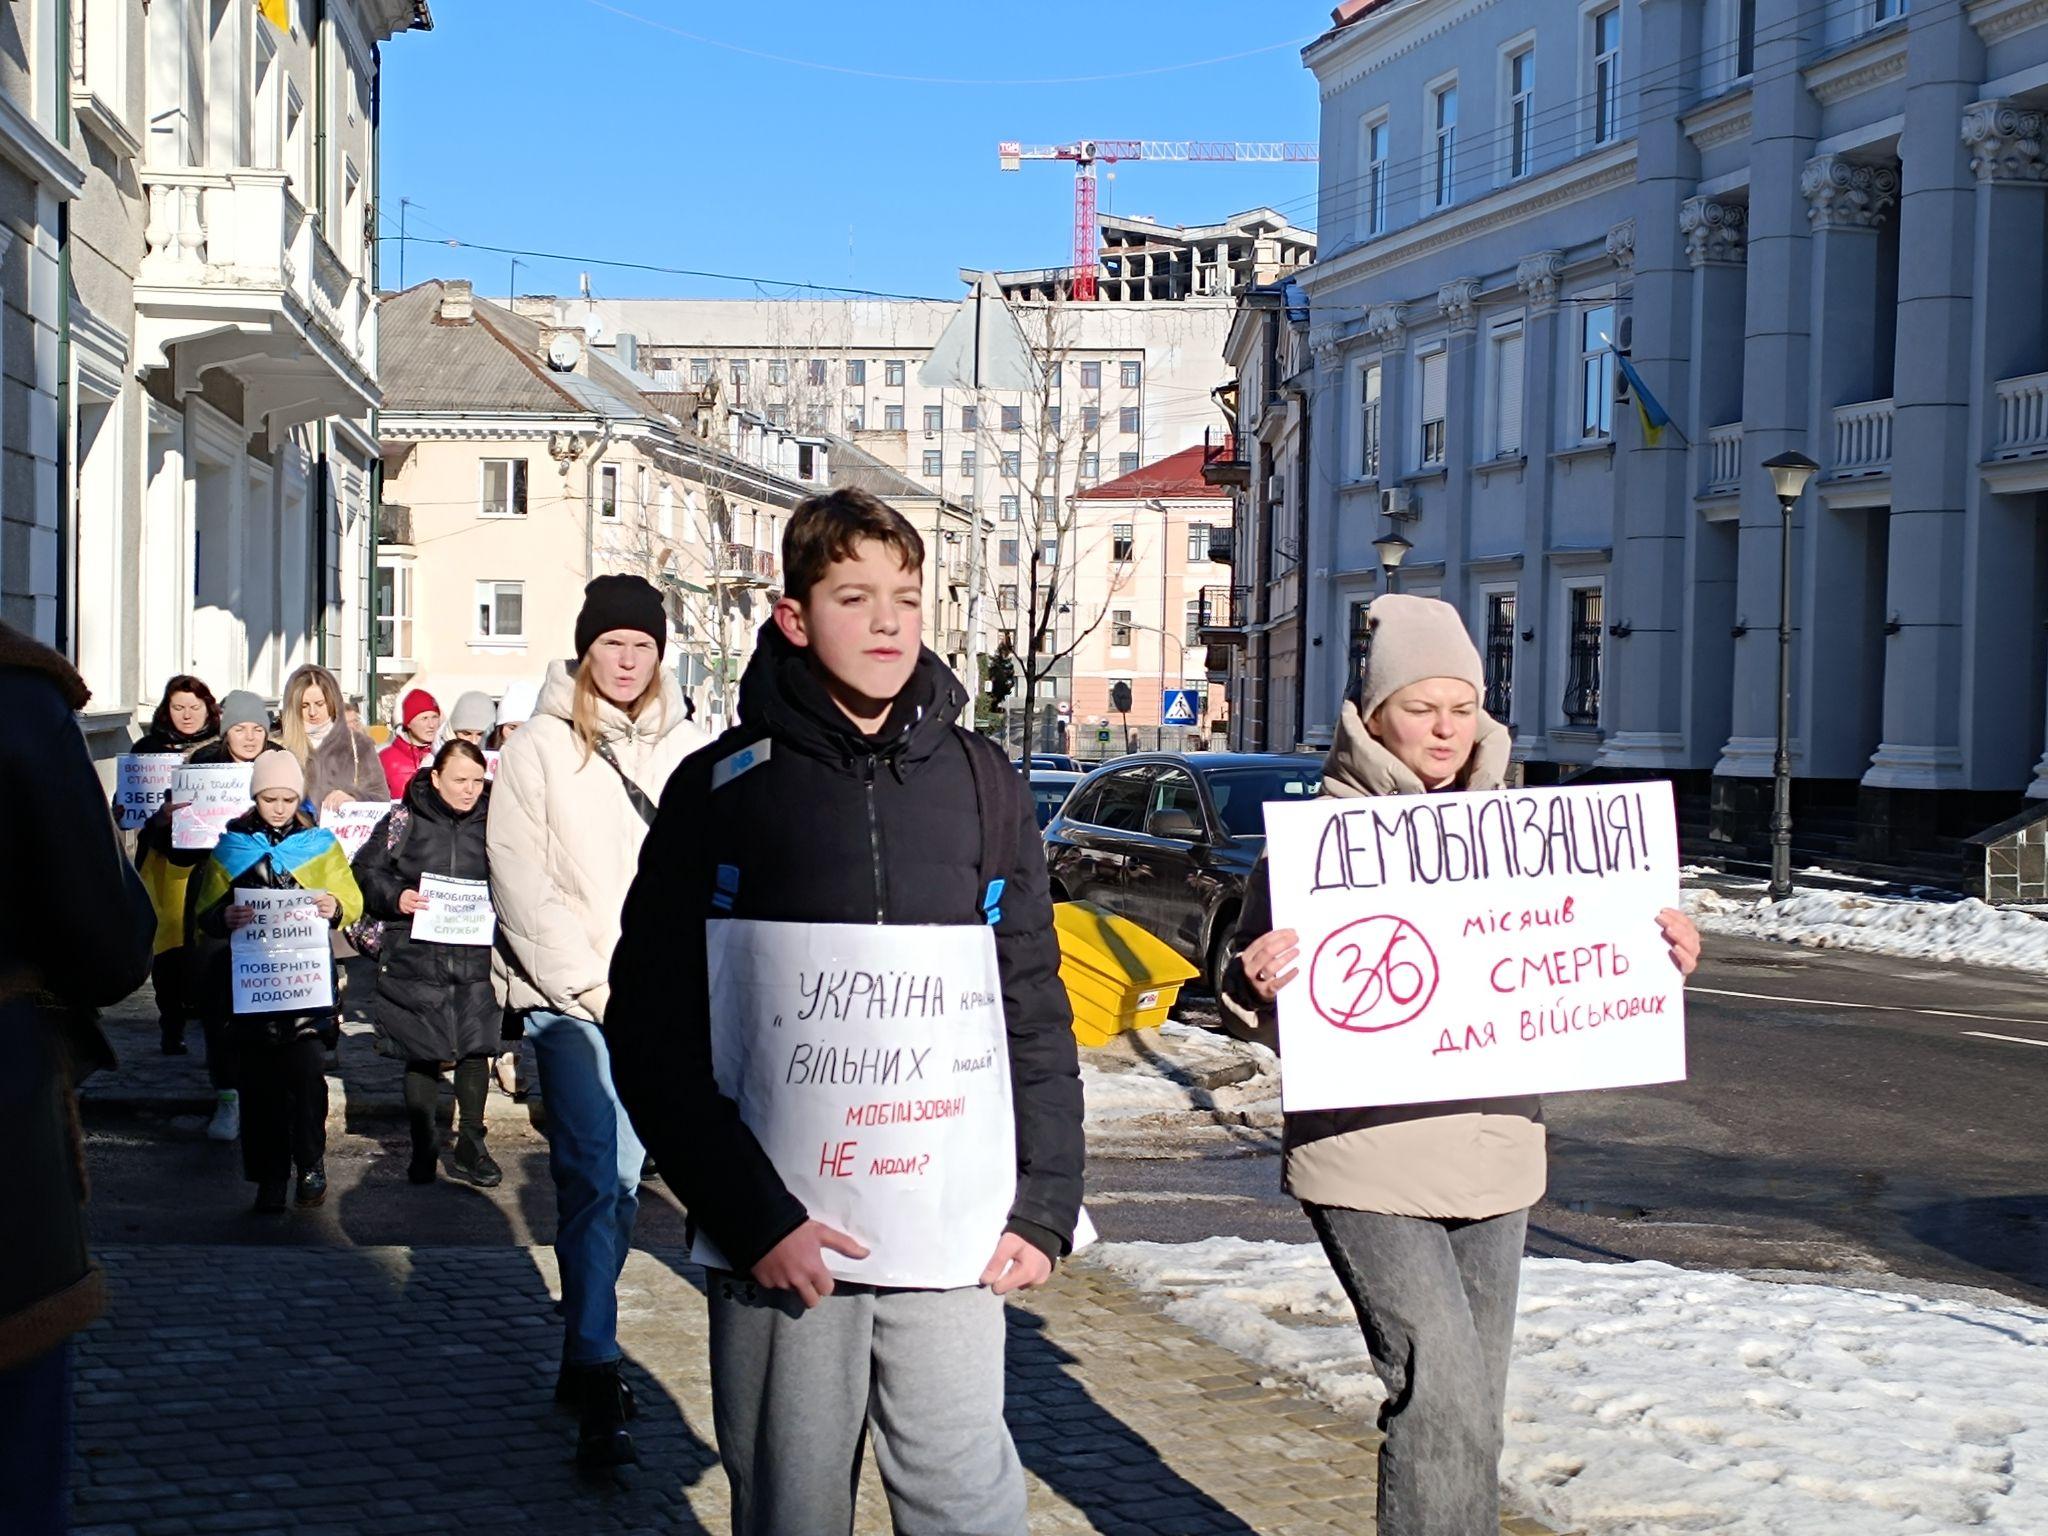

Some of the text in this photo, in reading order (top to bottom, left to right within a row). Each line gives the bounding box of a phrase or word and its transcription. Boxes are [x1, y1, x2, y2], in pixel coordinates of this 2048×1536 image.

[125, 764, 156, 773] ВОНИ
[1310, 793, 1651, 894] ДЕМОБІЛІЗАЦІЯ!
[276, 896, 314, 908] ТАТО
[246, 924, 312, 940] НА ВІЙНІ
[240, 961, 321, 974] ПОВЕРНІТЬ
[1331, 935, 1423, 1017] 36
[1490, 943, 1629, 992] СМЕРТЬ
[241, 973, 322, 989] МОГО ТАТА
[251, 988, 313, 1003] ДОДОМУ
[786, 1039, 931, 1085] ВІЛЬНИХ
[845, 1096, 966, 1127] МОБІЛІЗОВАНІ
[819, 1140, 930, 1178] НЕ ЛЮДИ?
